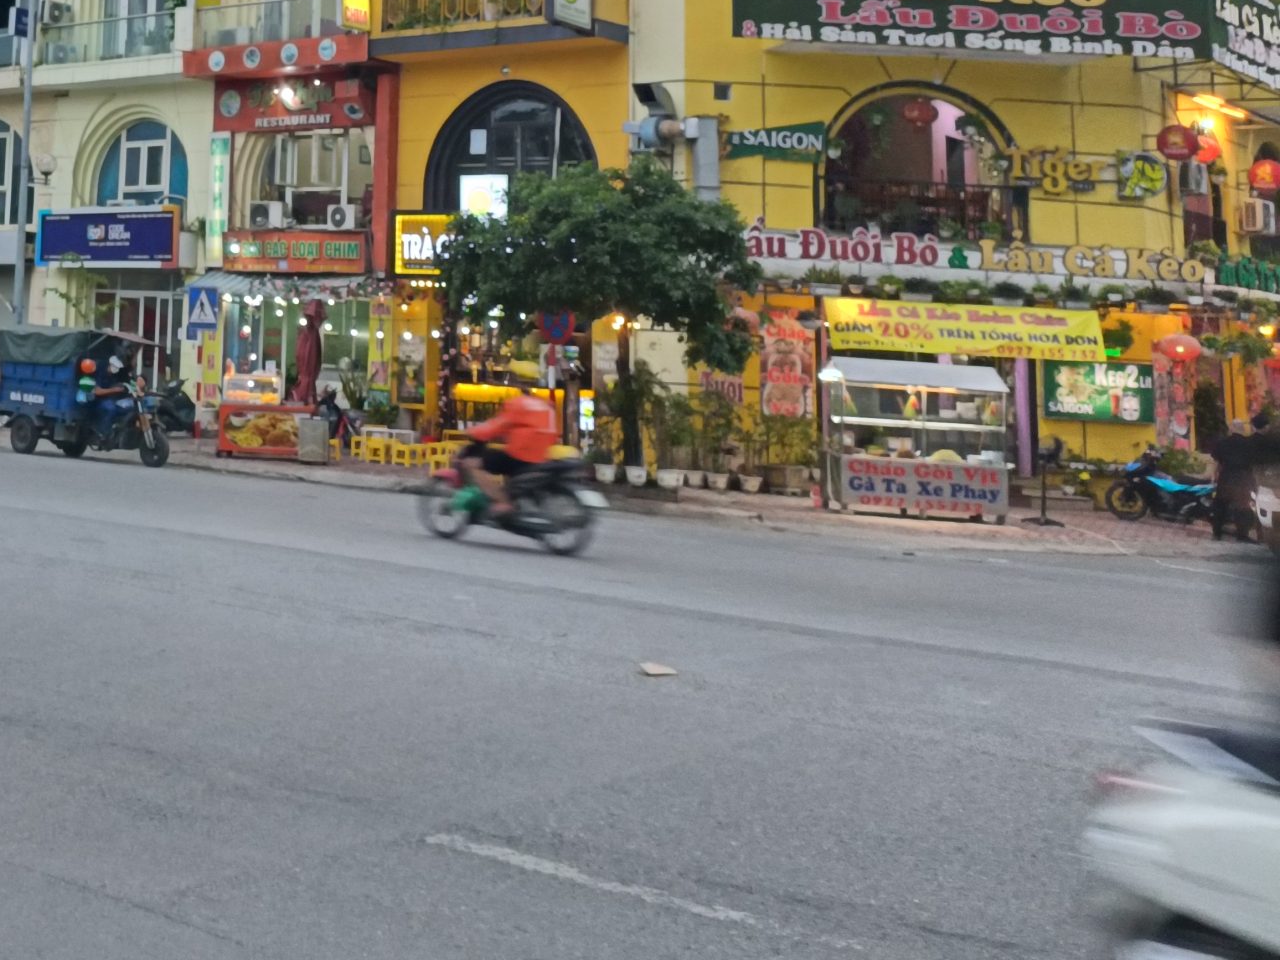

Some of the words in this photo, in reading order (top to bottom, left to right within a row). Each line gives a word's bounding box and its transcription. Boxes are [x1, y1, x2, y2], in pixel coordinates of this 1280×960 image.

[948, 4, 1106, 35] Đuôi
[1116, 10, 1201, 39] Bò
[1050, 36, 1123, 55] Bình
[1132, 40, 1195, 59] Dân
[255, 114, 331, 128] RESTAURANT
[743, 129, 823, 151] SAIGON
[1004, 145, 1107, 193] Tiger
[325, 240, 360, 258] CHIM
[401, 226, 434, 260] TRÀ
[799, 227, 882, 263] Đuôi
[894, 233, 939, 266] Bò
[948, 246, 969, 269] &
[1064, 244, 1116, 277] Cá
[1126, 247, 1206, 283] Kèo
[879, 321, 933, 340] 20%
[848, 458, 907, 477] Cháo
[849, 475, 875, 491] Gà
[882, 478, 907, 494] Ta
[917, 481, 944, 496] Xe
[949, 482, 1000, 504] Phay
